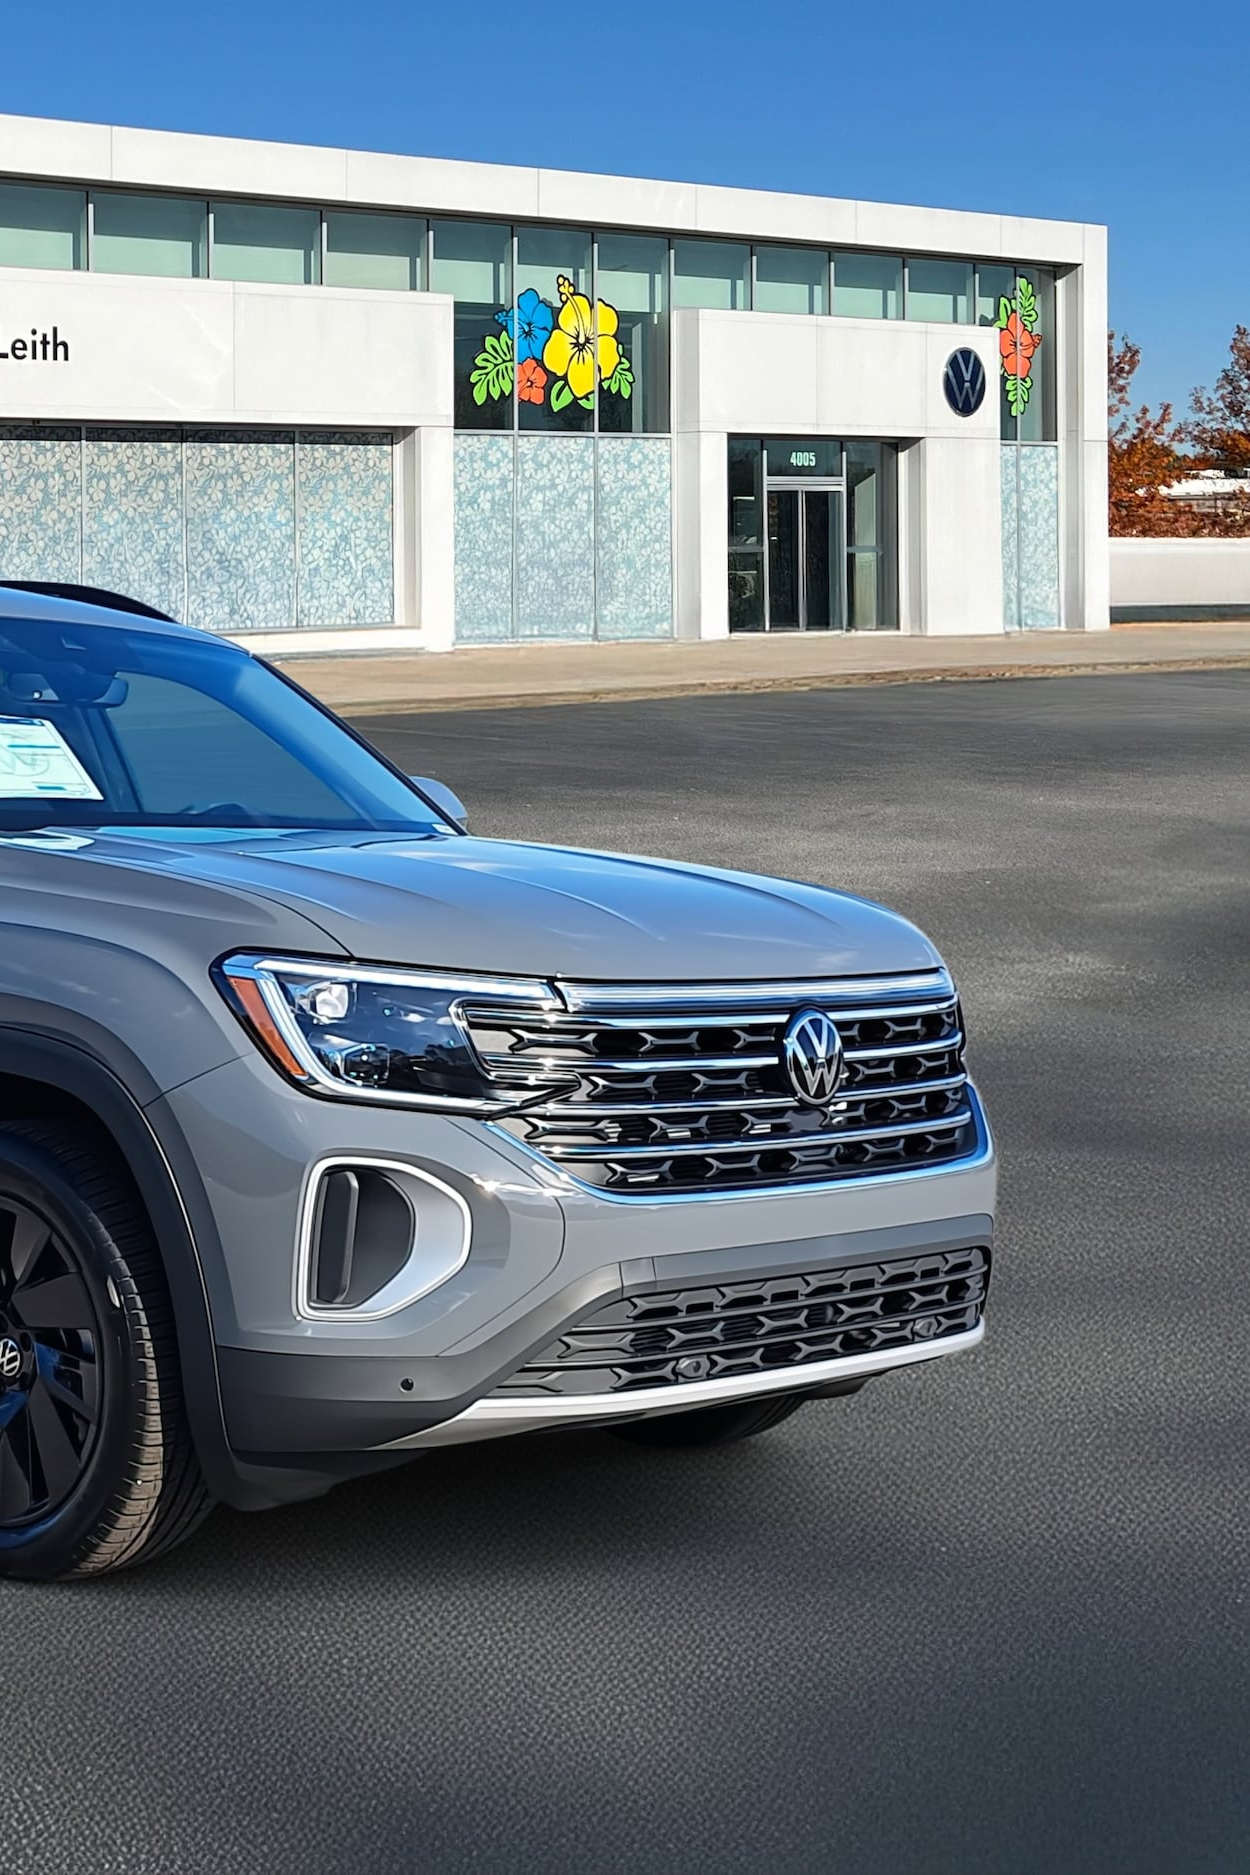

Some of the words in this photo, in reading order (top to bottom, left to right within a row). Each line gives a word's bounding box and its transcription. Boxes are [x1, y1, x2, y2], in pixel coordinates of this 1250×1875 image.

[943, 347, 986, 417] VW
[790, 452, 816, 466] 4005
[786, 1009, 842, 1104] VW
